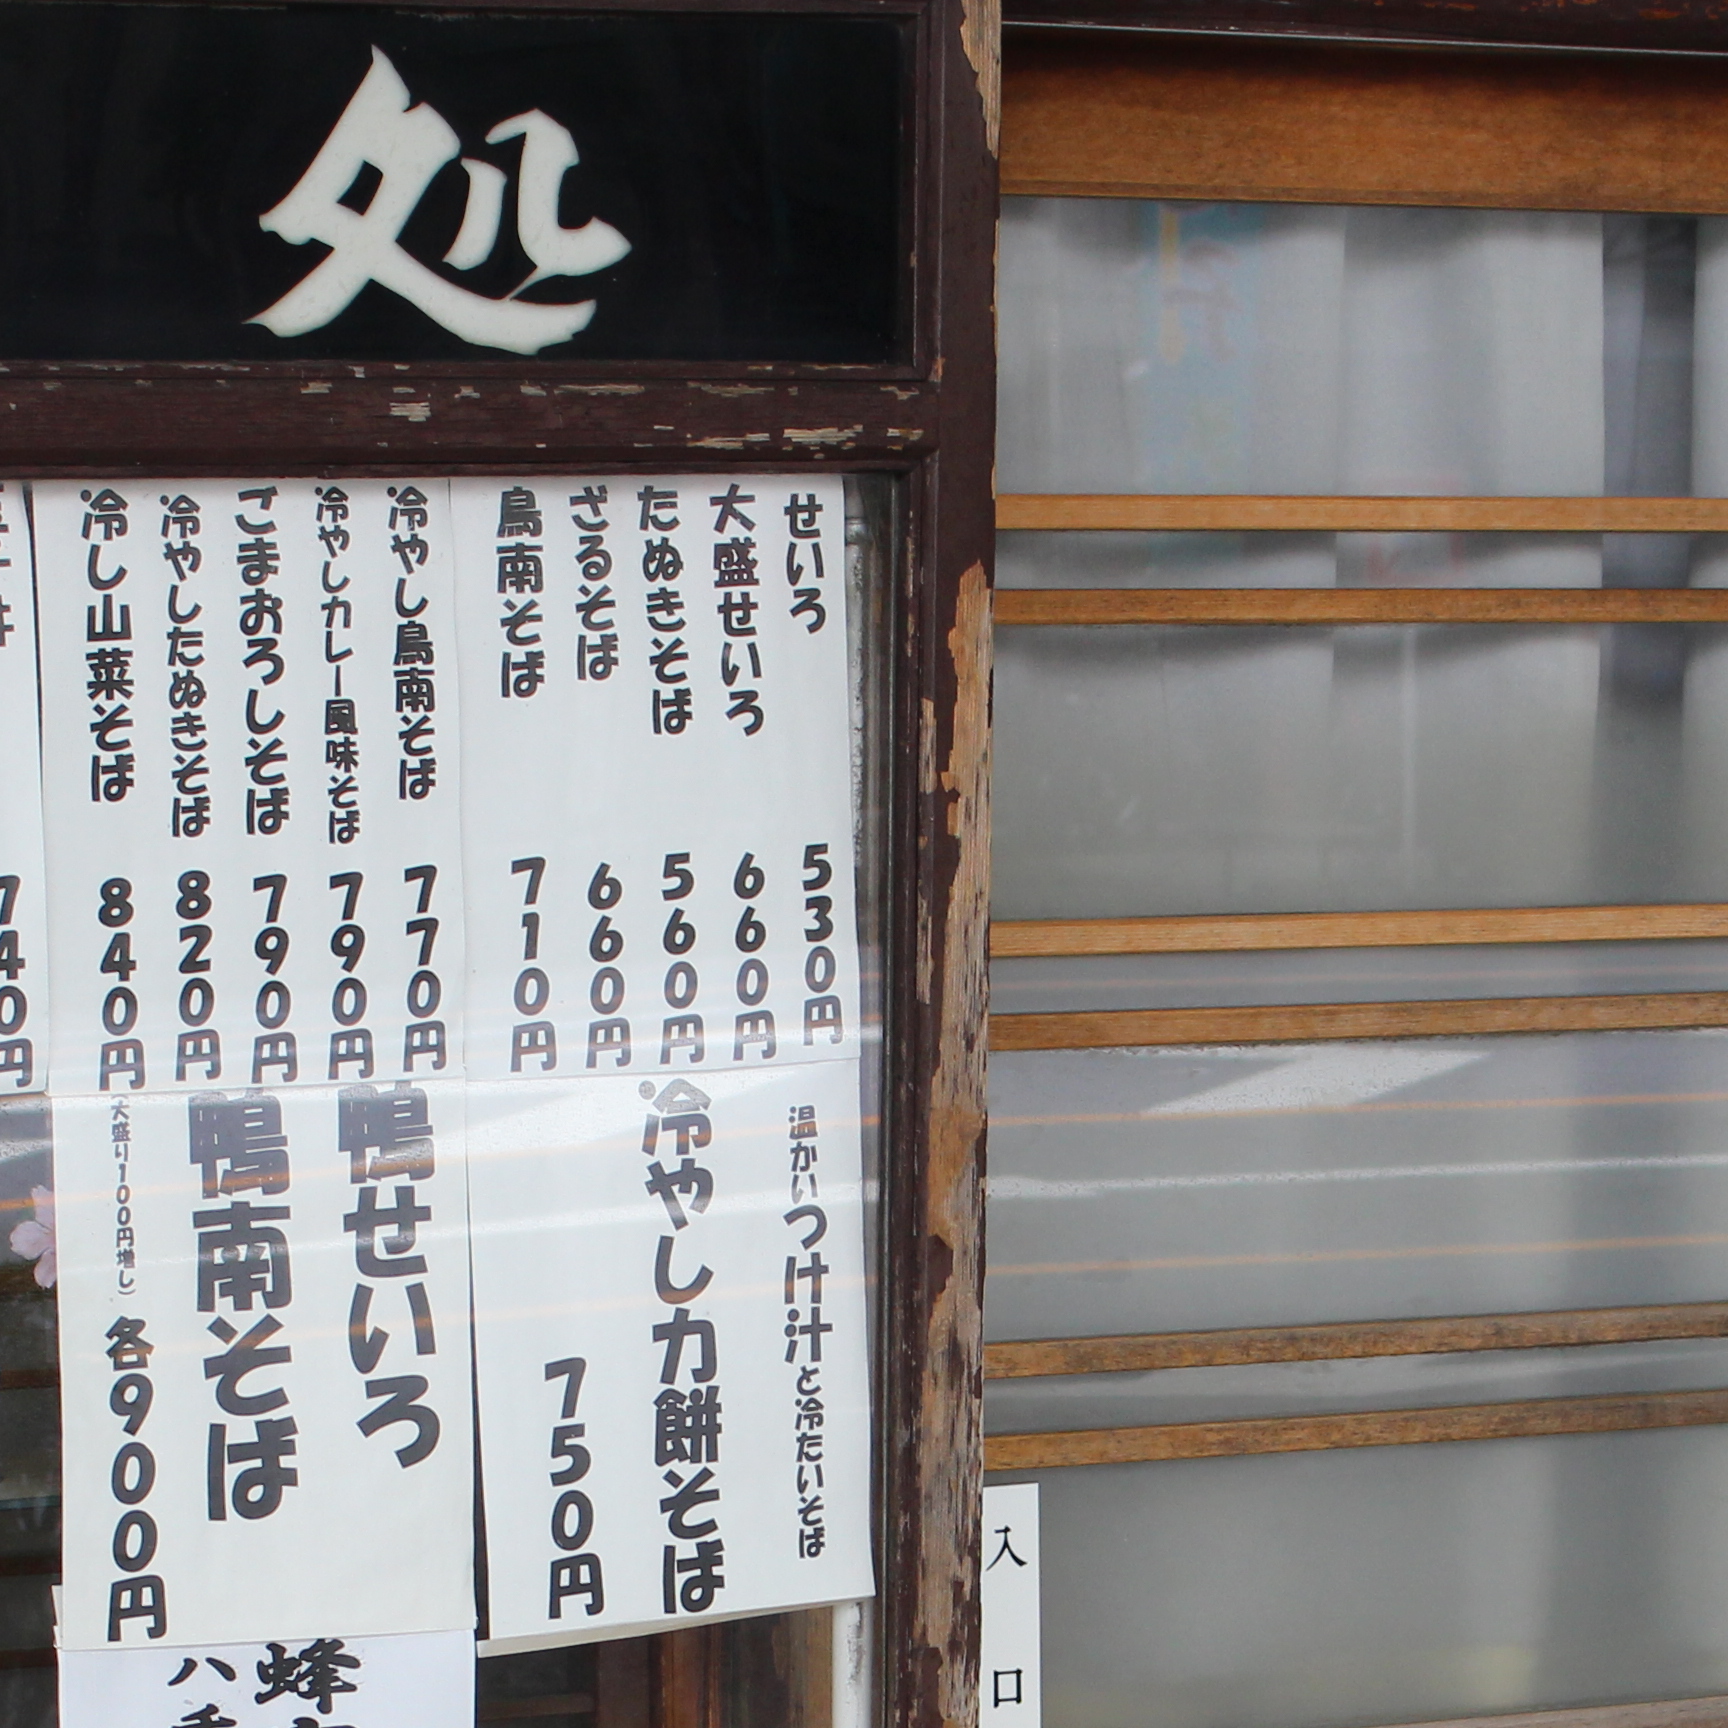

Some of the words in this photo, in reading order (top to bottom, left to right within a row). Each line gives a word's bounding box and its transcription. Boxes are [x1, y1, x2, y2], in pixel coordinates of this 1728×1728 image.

[80, 488, 136, 803] 冷し山菜そば
[160, 494, 211, 838] 冷やしたぬきそば
[234, 484, 291, 836] ごまおろしそば
[314, 485, 362, 846] 冷やしカレー風味そば
[387, 485, 437, 801] 冷やし鳥南そば
[496, 485, 546, 700] 鳥南そば
[568, 485, 619, 682] ざるそば
[636, 485, 693, 736] たぬきそば
[709, 483, 765, 737] 大盛せいろ
[783, 492, 828, 634] せいろ
[96, 876, 145, 1092] 840円
[175, 869, 223, 1083] 820円
[251, 872, 298, 1085] 790円
[326, 871, 374, 1082] 790円
[402, 863, 448, 1074] 770円
[509, 856, 557, 1074] 710円
[585, 861, 634, 1069] 660円
[658, 850, 706, 1065] 560円
[731, 850, 776, 1062] 660円
[801, 842, 843, 1047] 530円
[188, 1089, 299, 1521] 鴨南そば
[338, 1080, 440, 1469] 鴨せいろ
[638, 1077, 726, 1615] 冷やし力餅そば
[783, 1105, 833, 1559] 温かいつけ汁と冷たいそば
[105, 1316, 167, 1642] 各900円
[543, 1357, 605, 1621] 750円
[986, 1525, 1028, 1708] 入口
